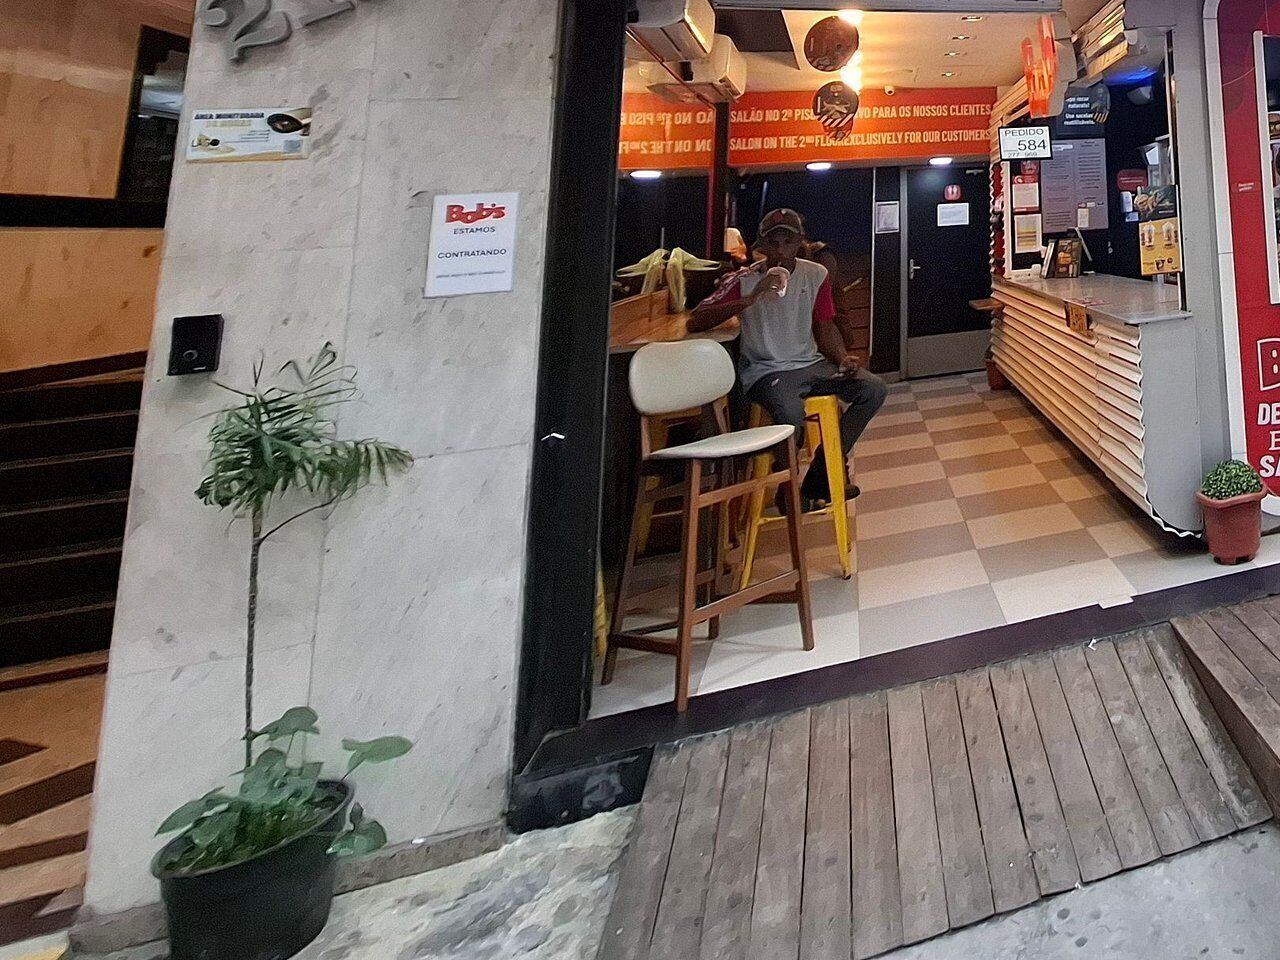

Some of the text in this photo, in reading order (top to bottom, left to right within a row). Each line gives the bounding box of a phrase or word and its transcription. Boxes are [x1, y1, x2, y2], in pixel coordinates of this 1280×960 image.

[731, 107, 762, 123] SALÃO
[765, 109, 779, 122] NO
[873, 107, 897, 119] PARA
[900, 106, 911, 118] OS
[914, 104, 948, 117] NOSSOS
[950, 103, 991, 116] CLIENTES
[1005, 128, 1044, 137] PEDIDO
[729, 138, 762, 150] SALON
[764, 137, 777, 149] ON
[779, 136, 798, 148] THE
[905, 132, 921, 143] FOR
[922, 131, 940, 142] OUR
[942, 129, 991, 142] CUSTOMERS
[1018, 139, 1047, 151] 584
[445, 203, 506, 224] Bob's
[453, 226, 496, 235] ESTAMOS
[437, 248, 507, 259] CONTRATANDO
